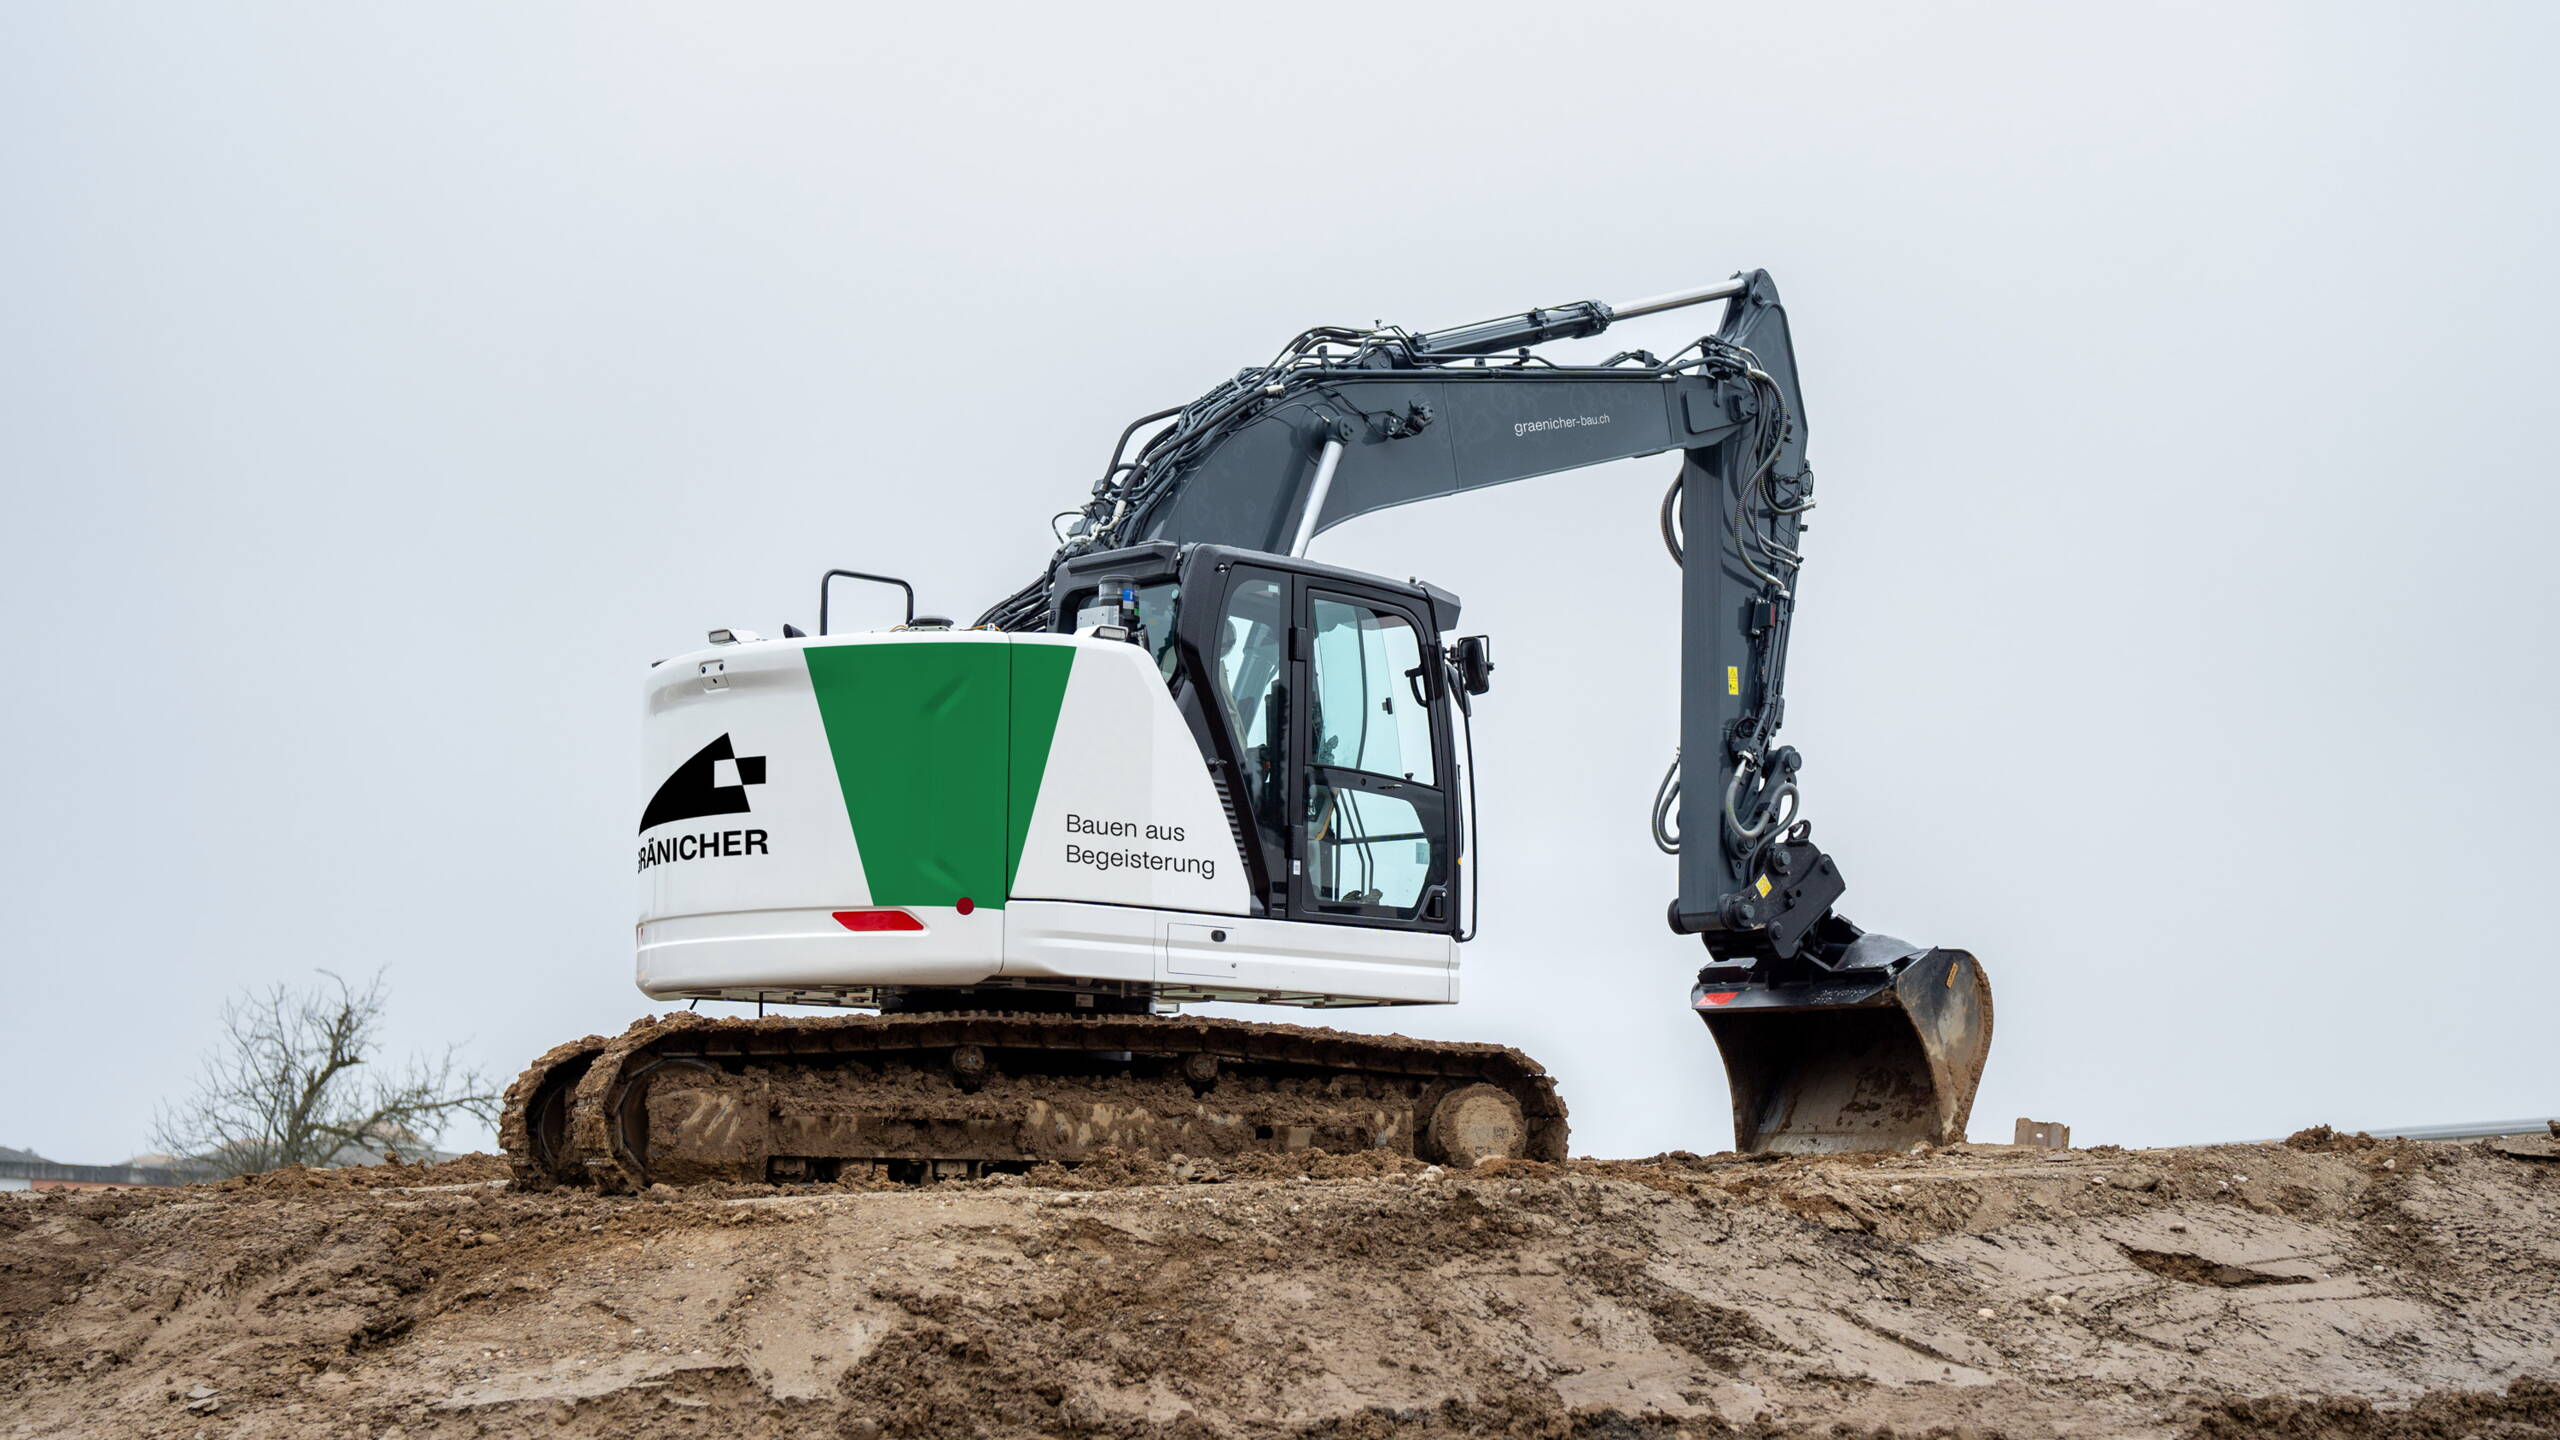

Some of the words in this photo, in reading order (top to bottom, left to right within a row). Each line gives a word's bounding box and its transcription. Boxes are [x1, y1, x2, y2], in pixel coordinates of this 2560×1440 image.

[1514, 413, 1611, 437] graenicher-bau.ch
[1066, 813, 1138, 838] Bauen
[1145, 824, 1186, 842] aus
[637, 829, 769, 875] RÄNICHER
[1066, 844, 1215, 880] Begeisterung
